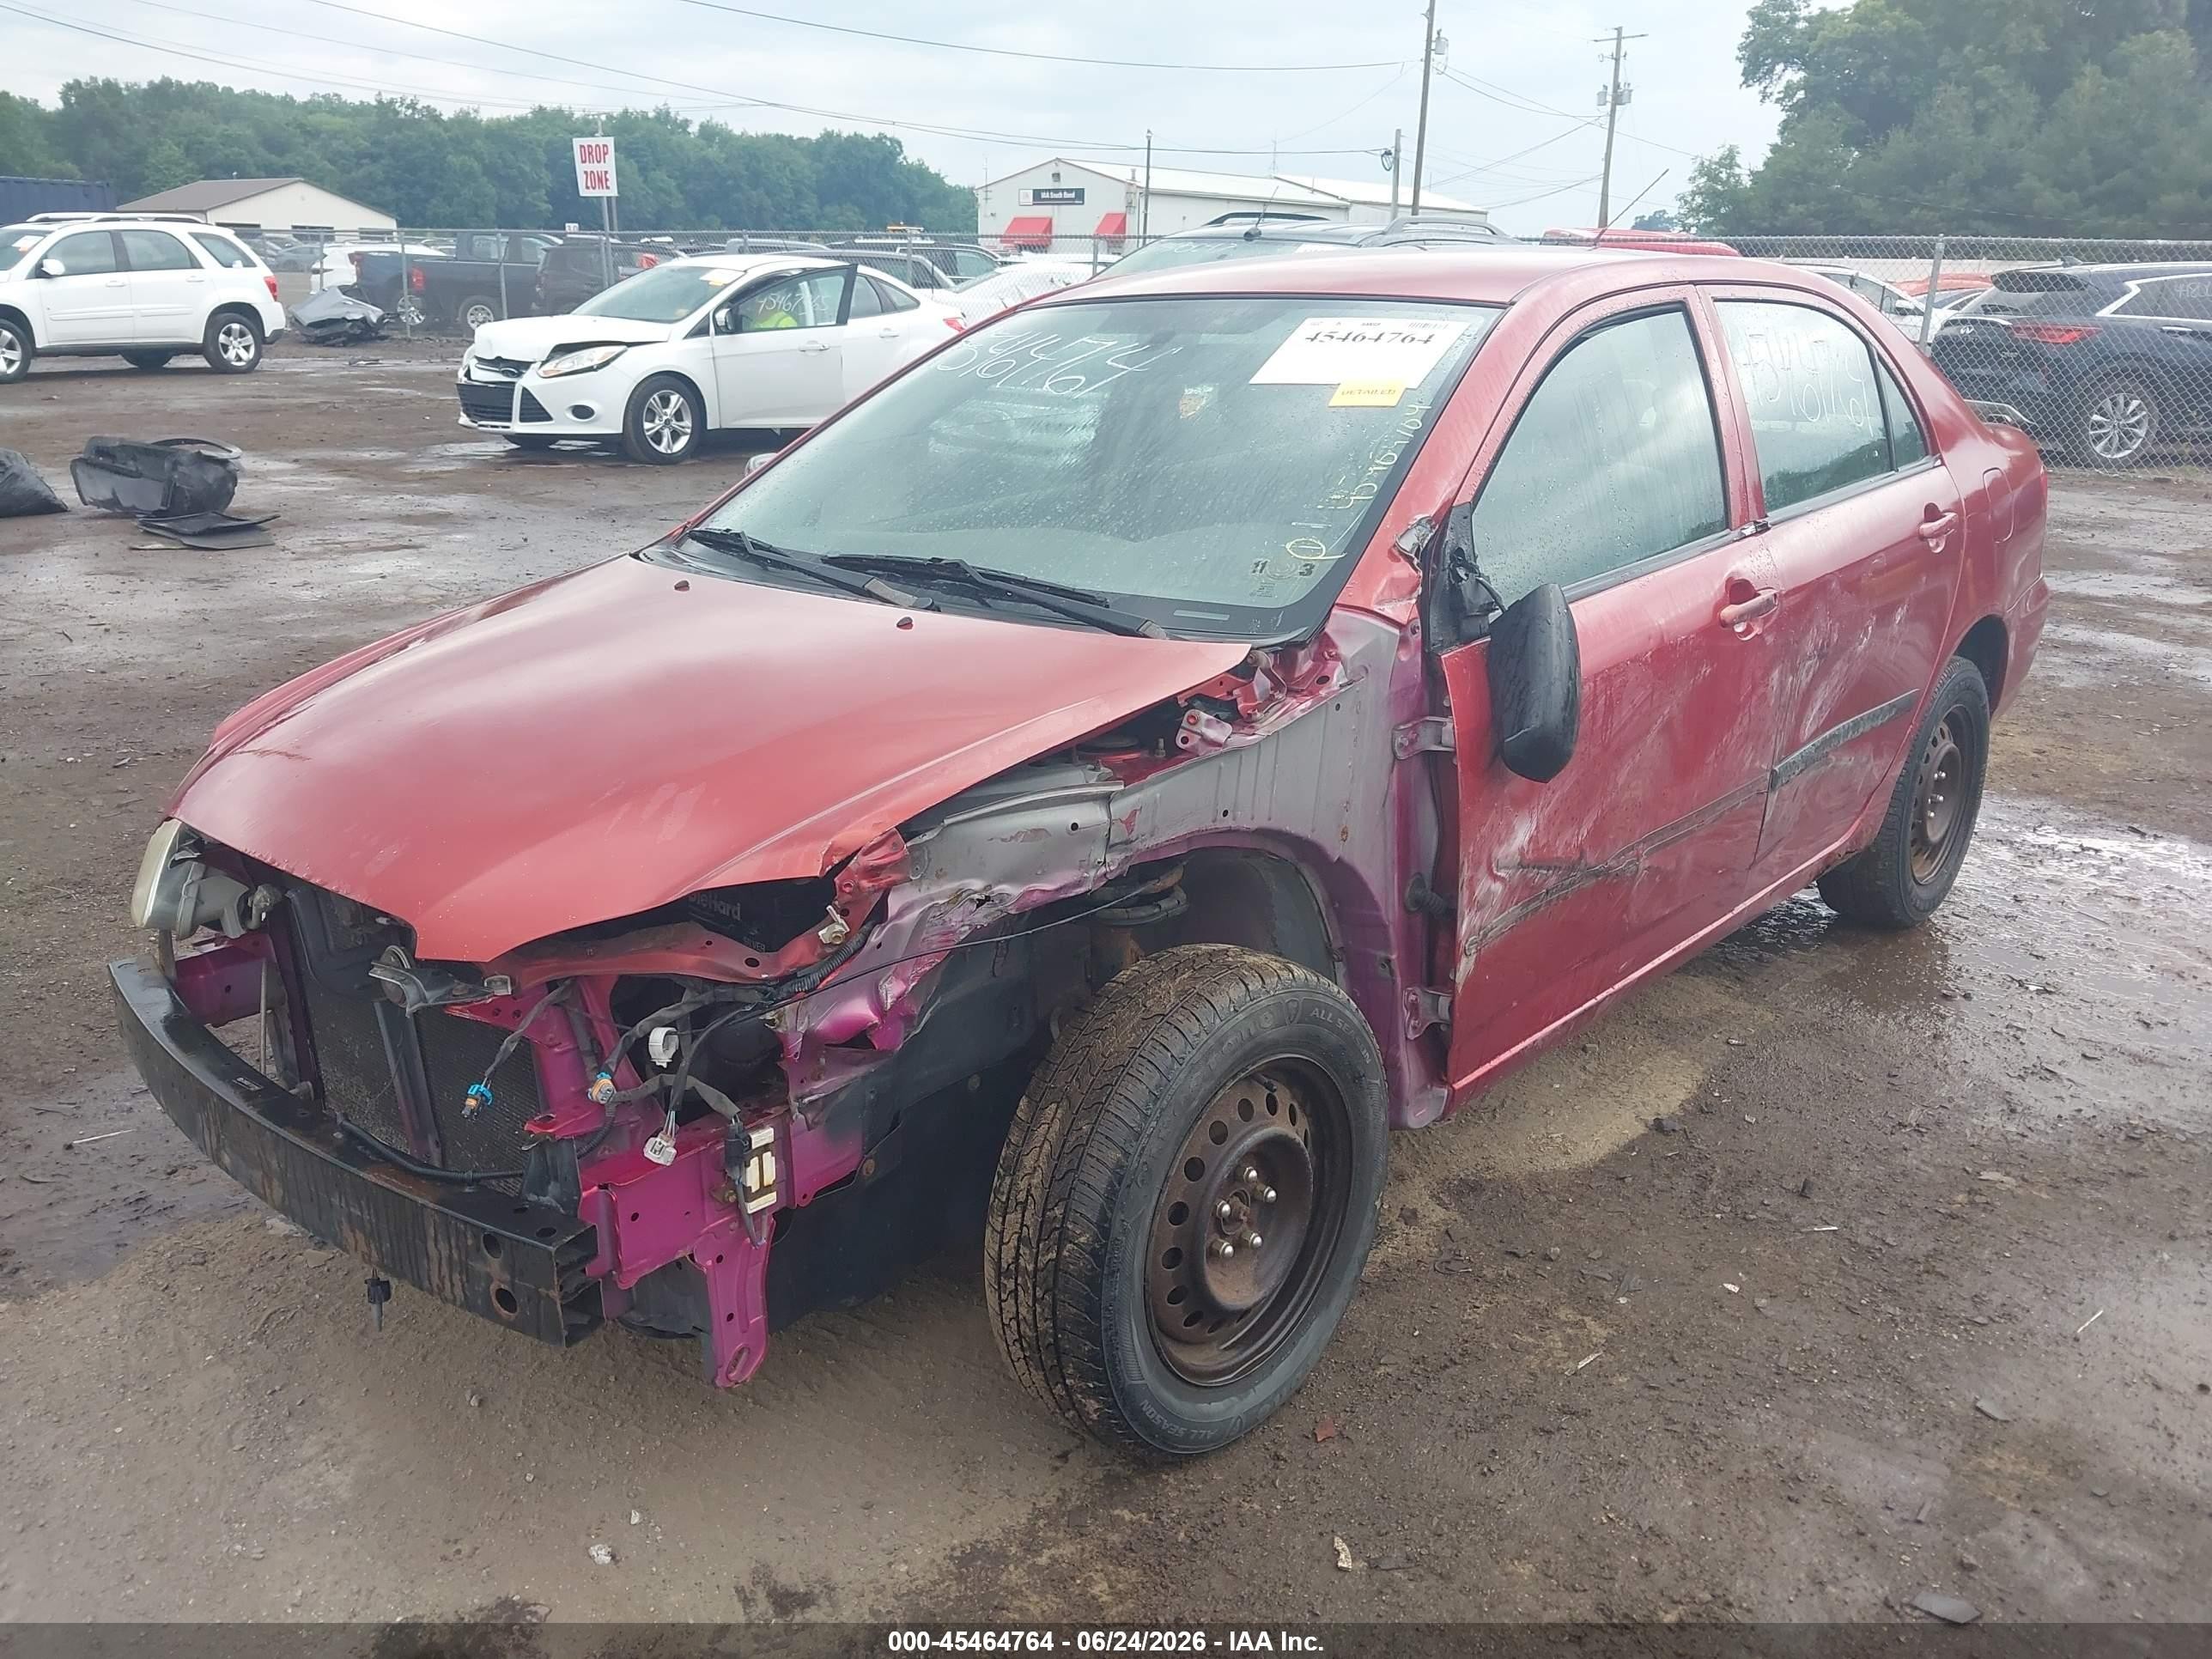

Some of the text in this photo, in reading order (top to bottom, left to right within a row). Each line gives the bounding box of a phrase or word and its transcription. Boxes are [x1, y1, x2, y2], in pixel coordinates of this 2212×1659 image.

[579, 143, 609, 164] DROP
[583, 170, 611, 190] ZONE
[1305, 331, 1436, 344] 45464764
[1298, 562, 1316, 577] 3
[1310, 1007, 1334, 1024] ALL
[1139, 1399, 1188, 1437] SEASON
